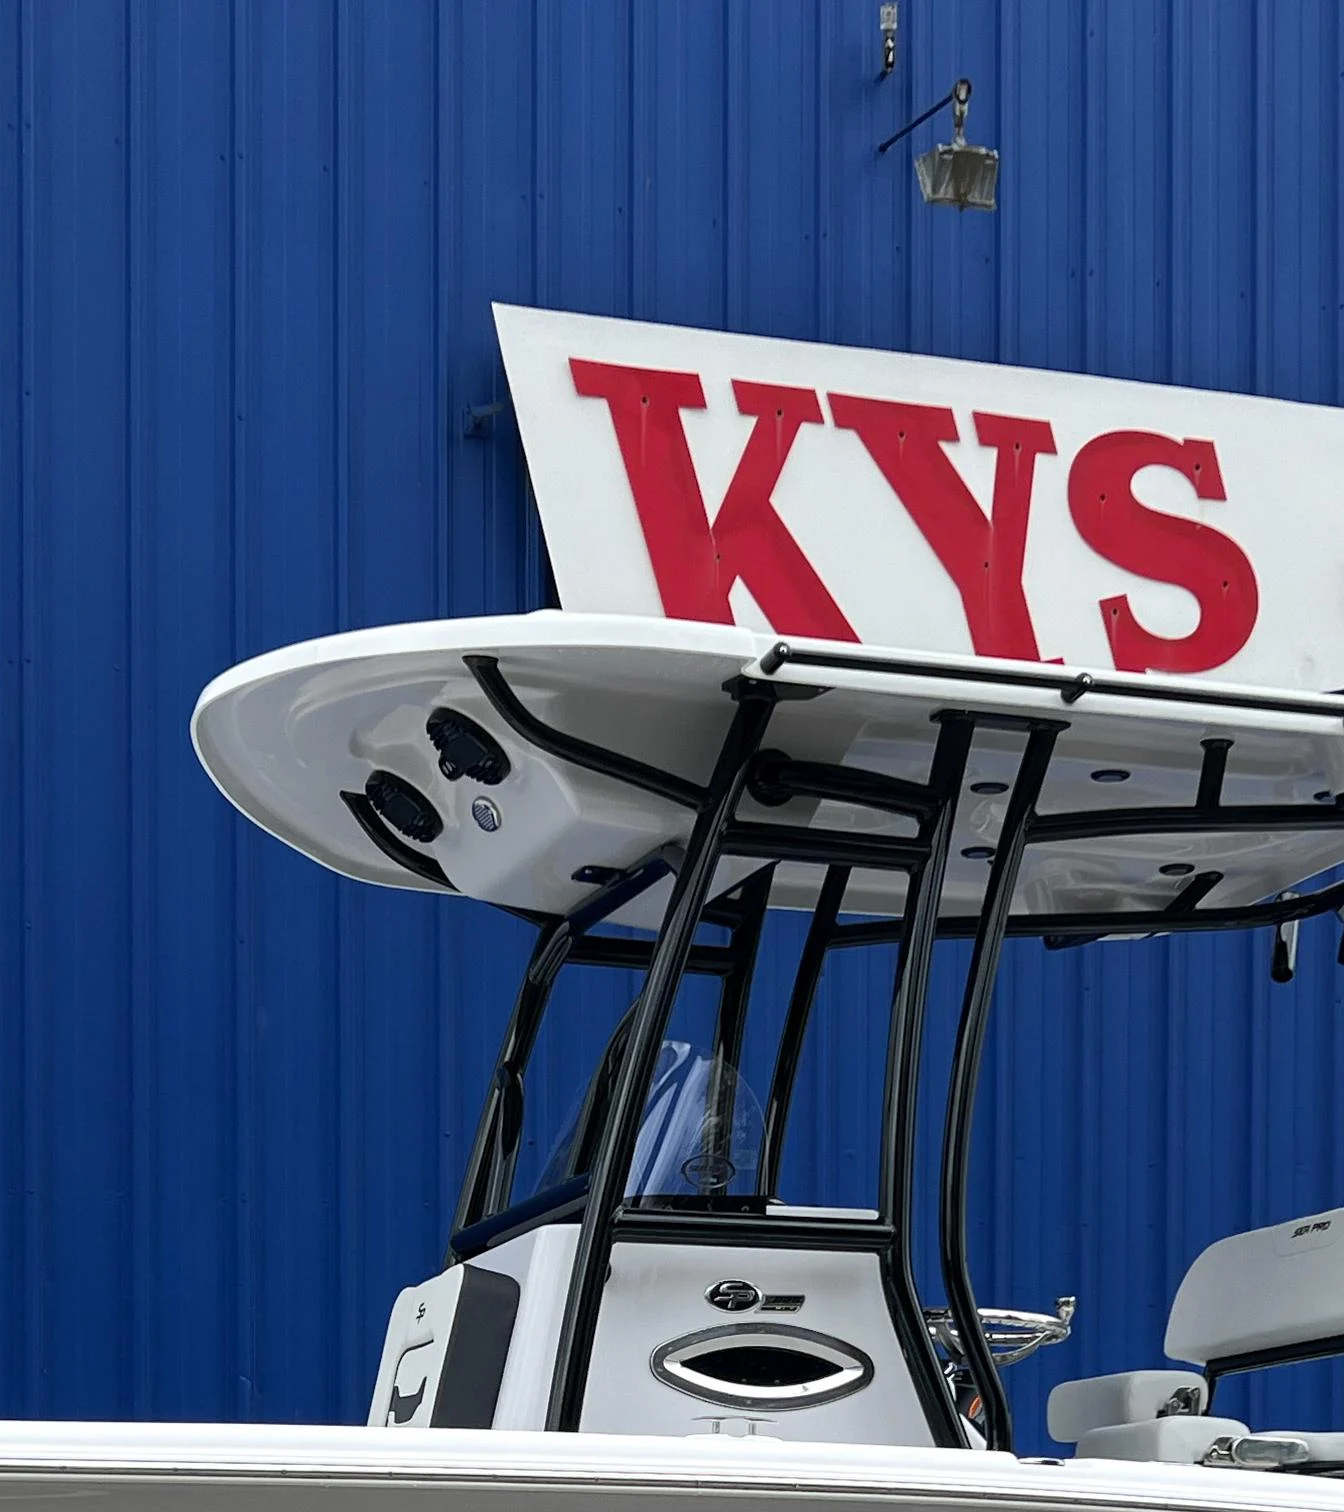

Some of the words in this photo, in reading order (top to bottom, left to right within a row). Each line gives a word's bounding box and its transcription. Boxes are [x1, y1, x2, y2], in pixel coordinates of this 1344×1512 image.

[567, 357, 1258, 674] KYS
[1290, 1224, 1312, 1239] SEA
[1311, 1220, 1332, 1233] PRO
